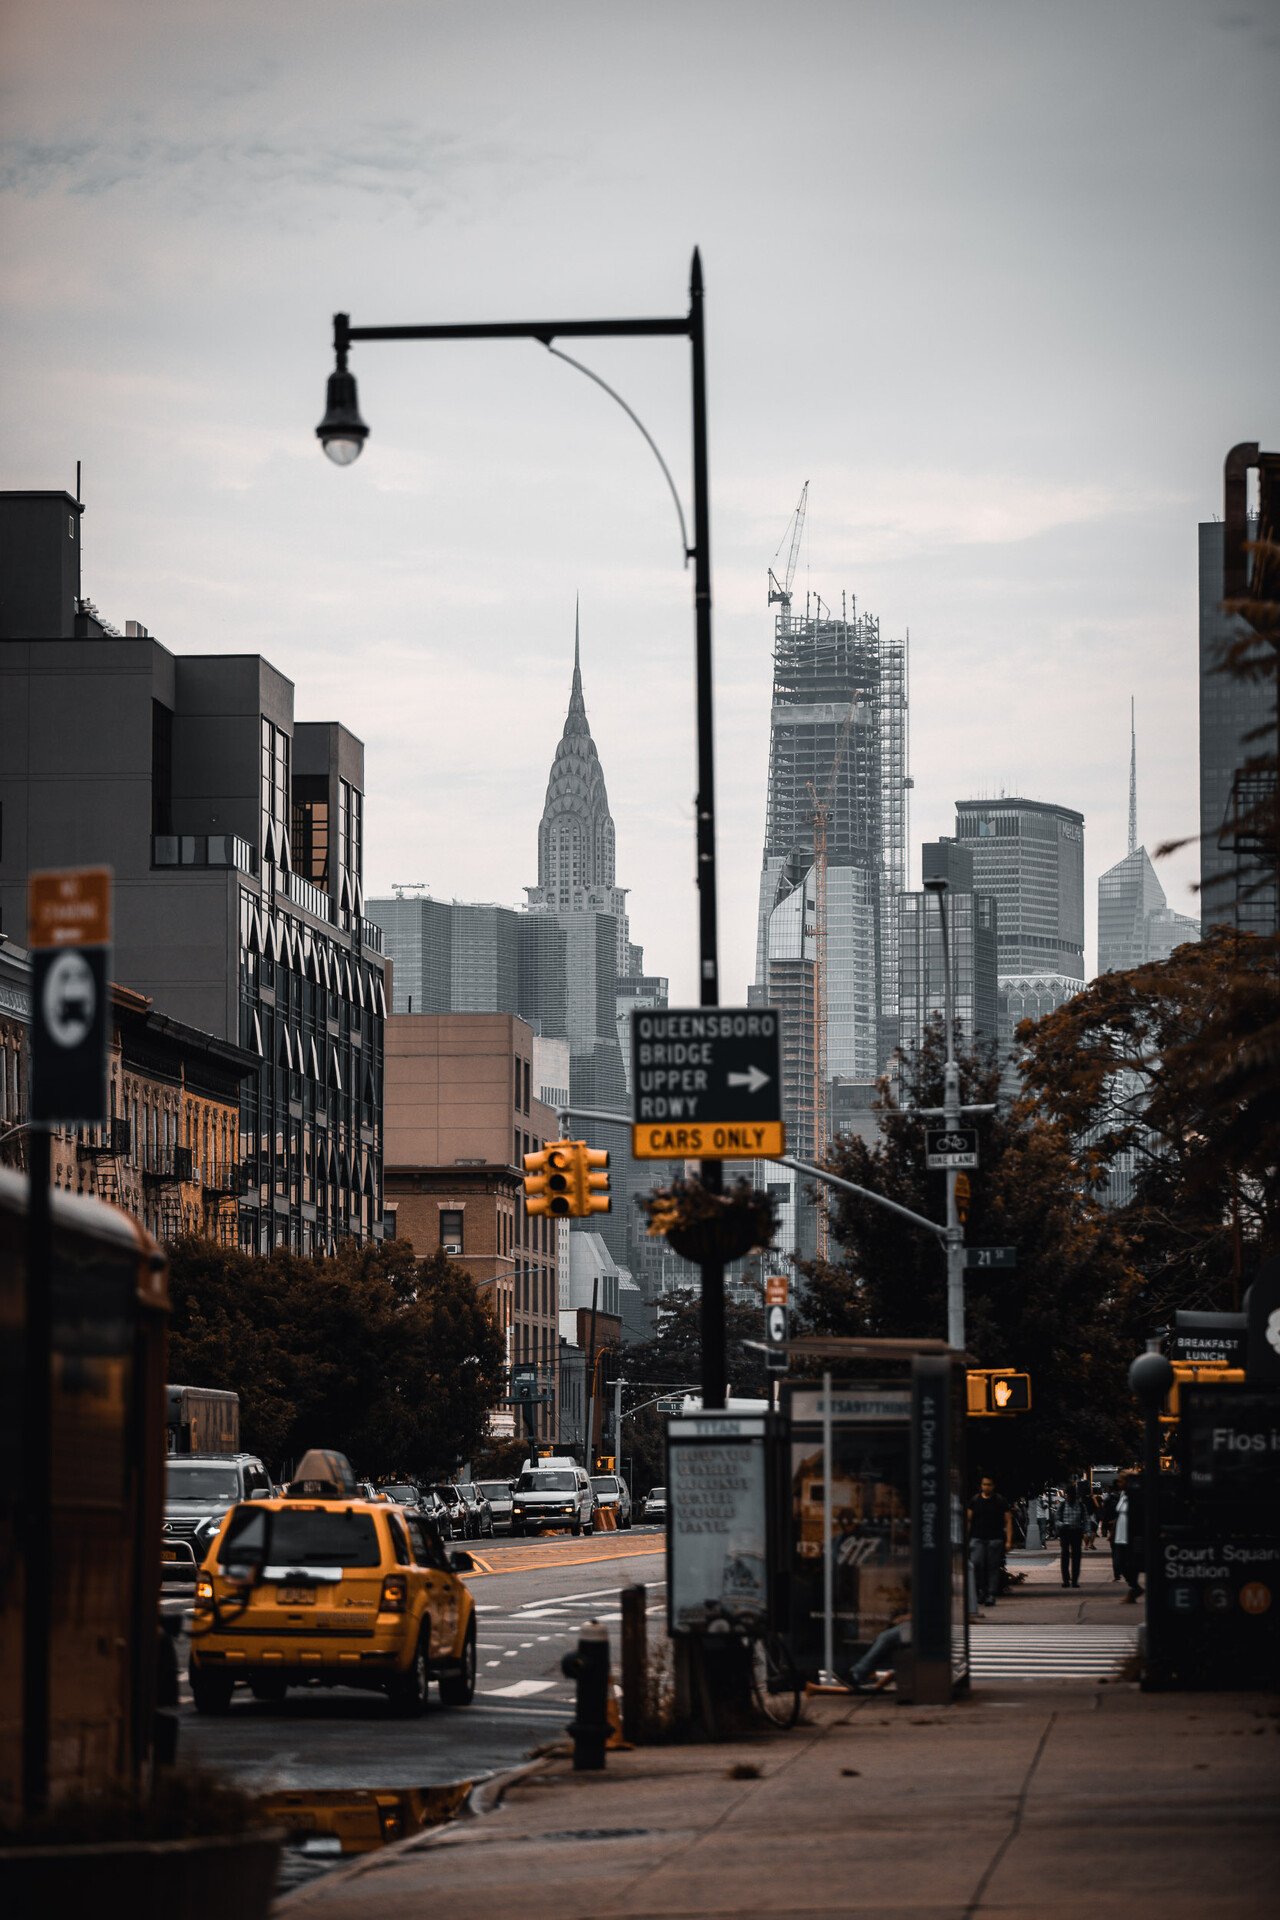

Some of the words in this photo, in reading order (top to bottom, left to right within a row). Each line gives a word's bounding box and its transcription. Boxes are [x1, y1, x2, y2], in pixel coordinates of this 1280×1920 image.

[639, 1015, 775, 1038] QUEENSBORO
[639, 1043, 713, 1065] BRIDGE
[640, 1069, 708, 1091] UPPER
[641, 1096, 698, 1118] RDWY
[649, 1128, 703, 1149] CARS
[713, 1127, 765, 1149] ONLY
[930, 1155, 948, 1164] BIKE
[952, 1154, 975, 1164] LANE
[977, 1250, 991, 1265] 21
[1177, 1337, 1239, 1349] BREAKFAST
[1185, 1351, 1226, 1361] LUNCH
[921, 1396, 935, 1415] 44
[696, 1421, 740, 1433] TITAN
[921, 1420, 935, 1459] Drive
[1212, 1428, 1266, 1450] Fios
[921, 1463, 935, 1475] &
[921, 1479, 935, 1496] 21
[921, 1502, 936, 1550] Street
[836, 1536, 882, 1567] 917
[1164, 1544, 1215, 1561] Court
[1165, 1562, 1230, 1578] Station
[1174, 1588, 1190, 1608] E
